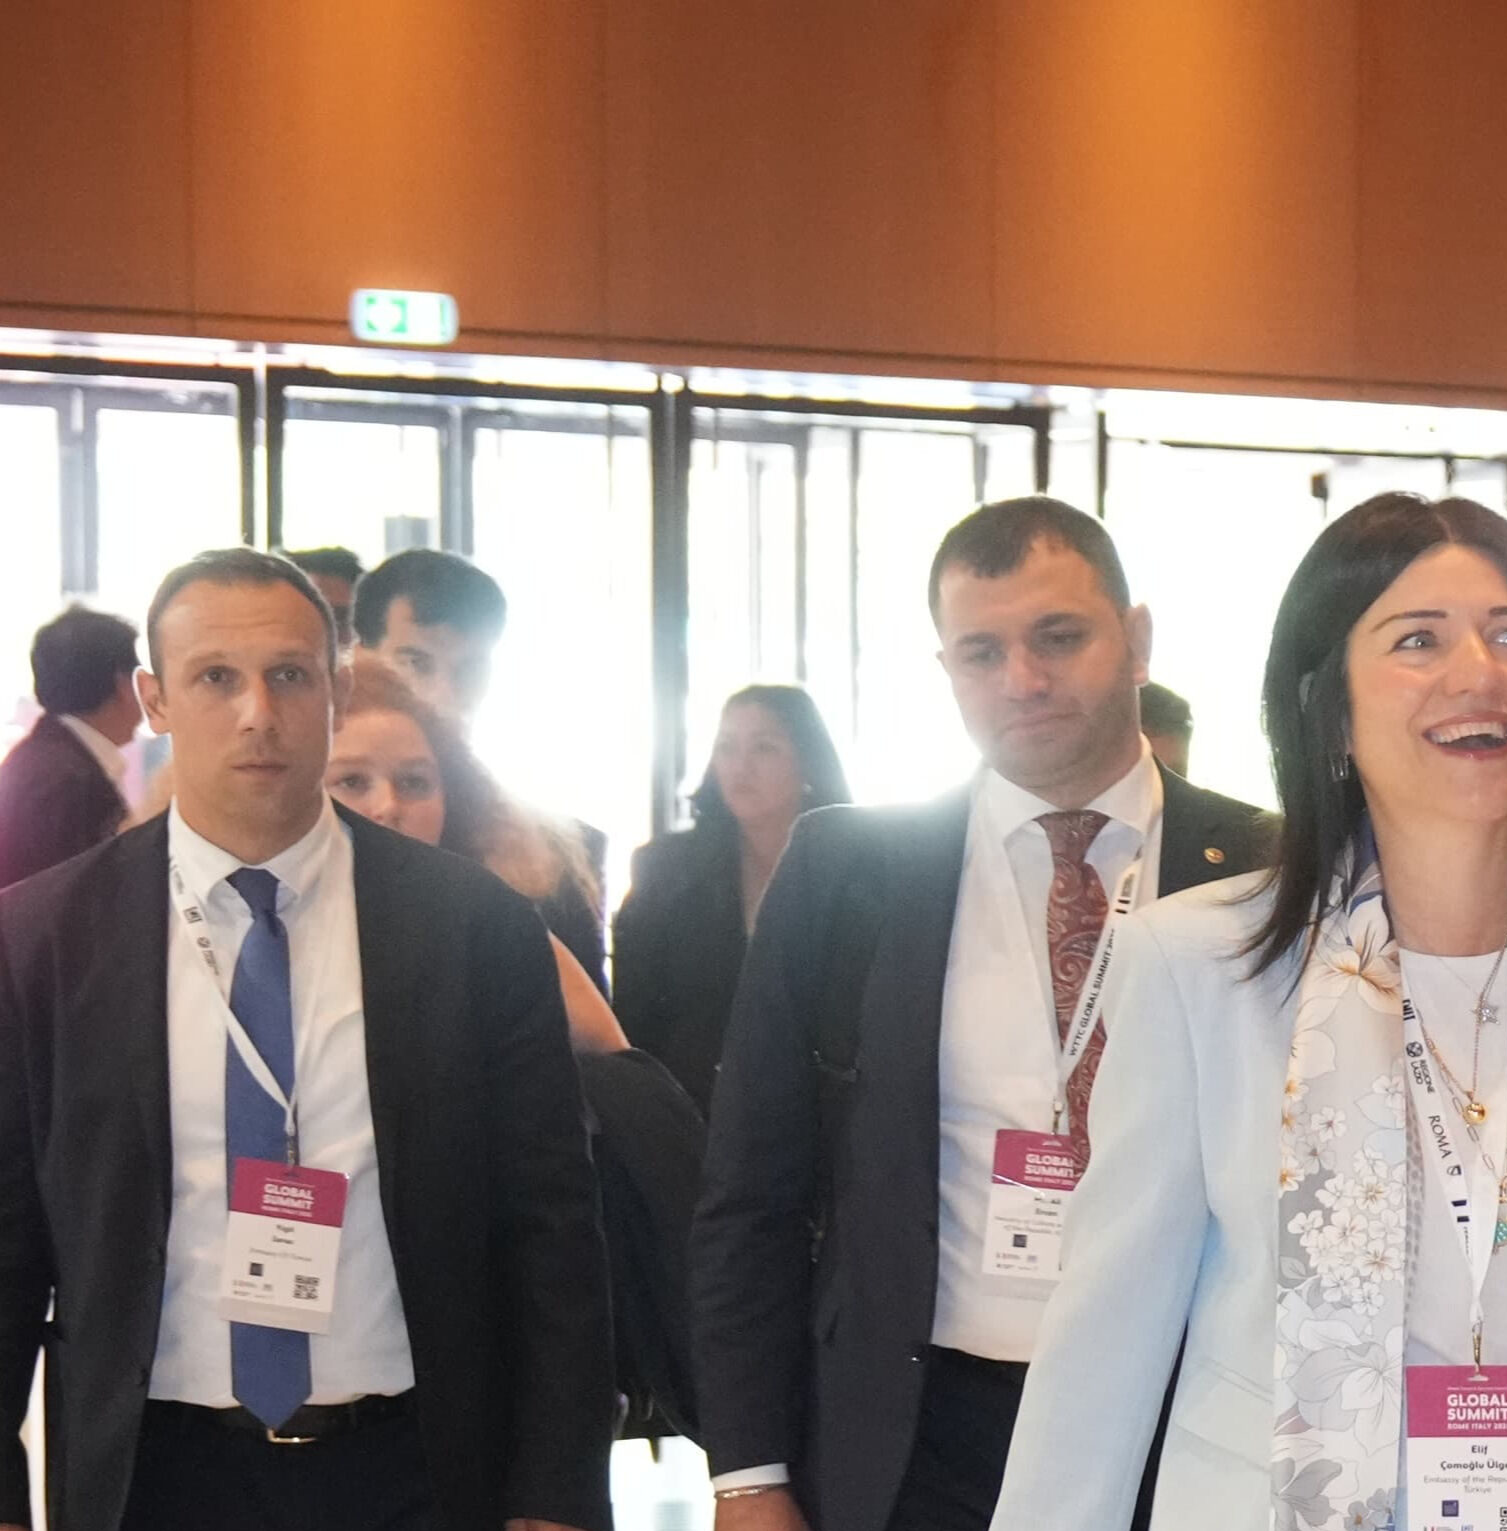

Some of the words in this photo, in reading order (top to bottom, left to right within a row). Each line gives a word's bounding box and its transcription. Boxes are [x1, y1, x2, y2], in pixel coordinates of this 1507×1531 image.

[1080, 990, 1099, 1028] GLOBAL
[1092, 951, 1112, 990] SUMMIT
[1410, 1061, 1423, 1085] LAZIO
[1418, 1059, 1435, 1095] REGIONE
[1428, 1114, 1452, 1160] ROMA
[1471, 1422, 1492, 1430] ITALY
[1471, 1445, 1488, 1455] Elif
